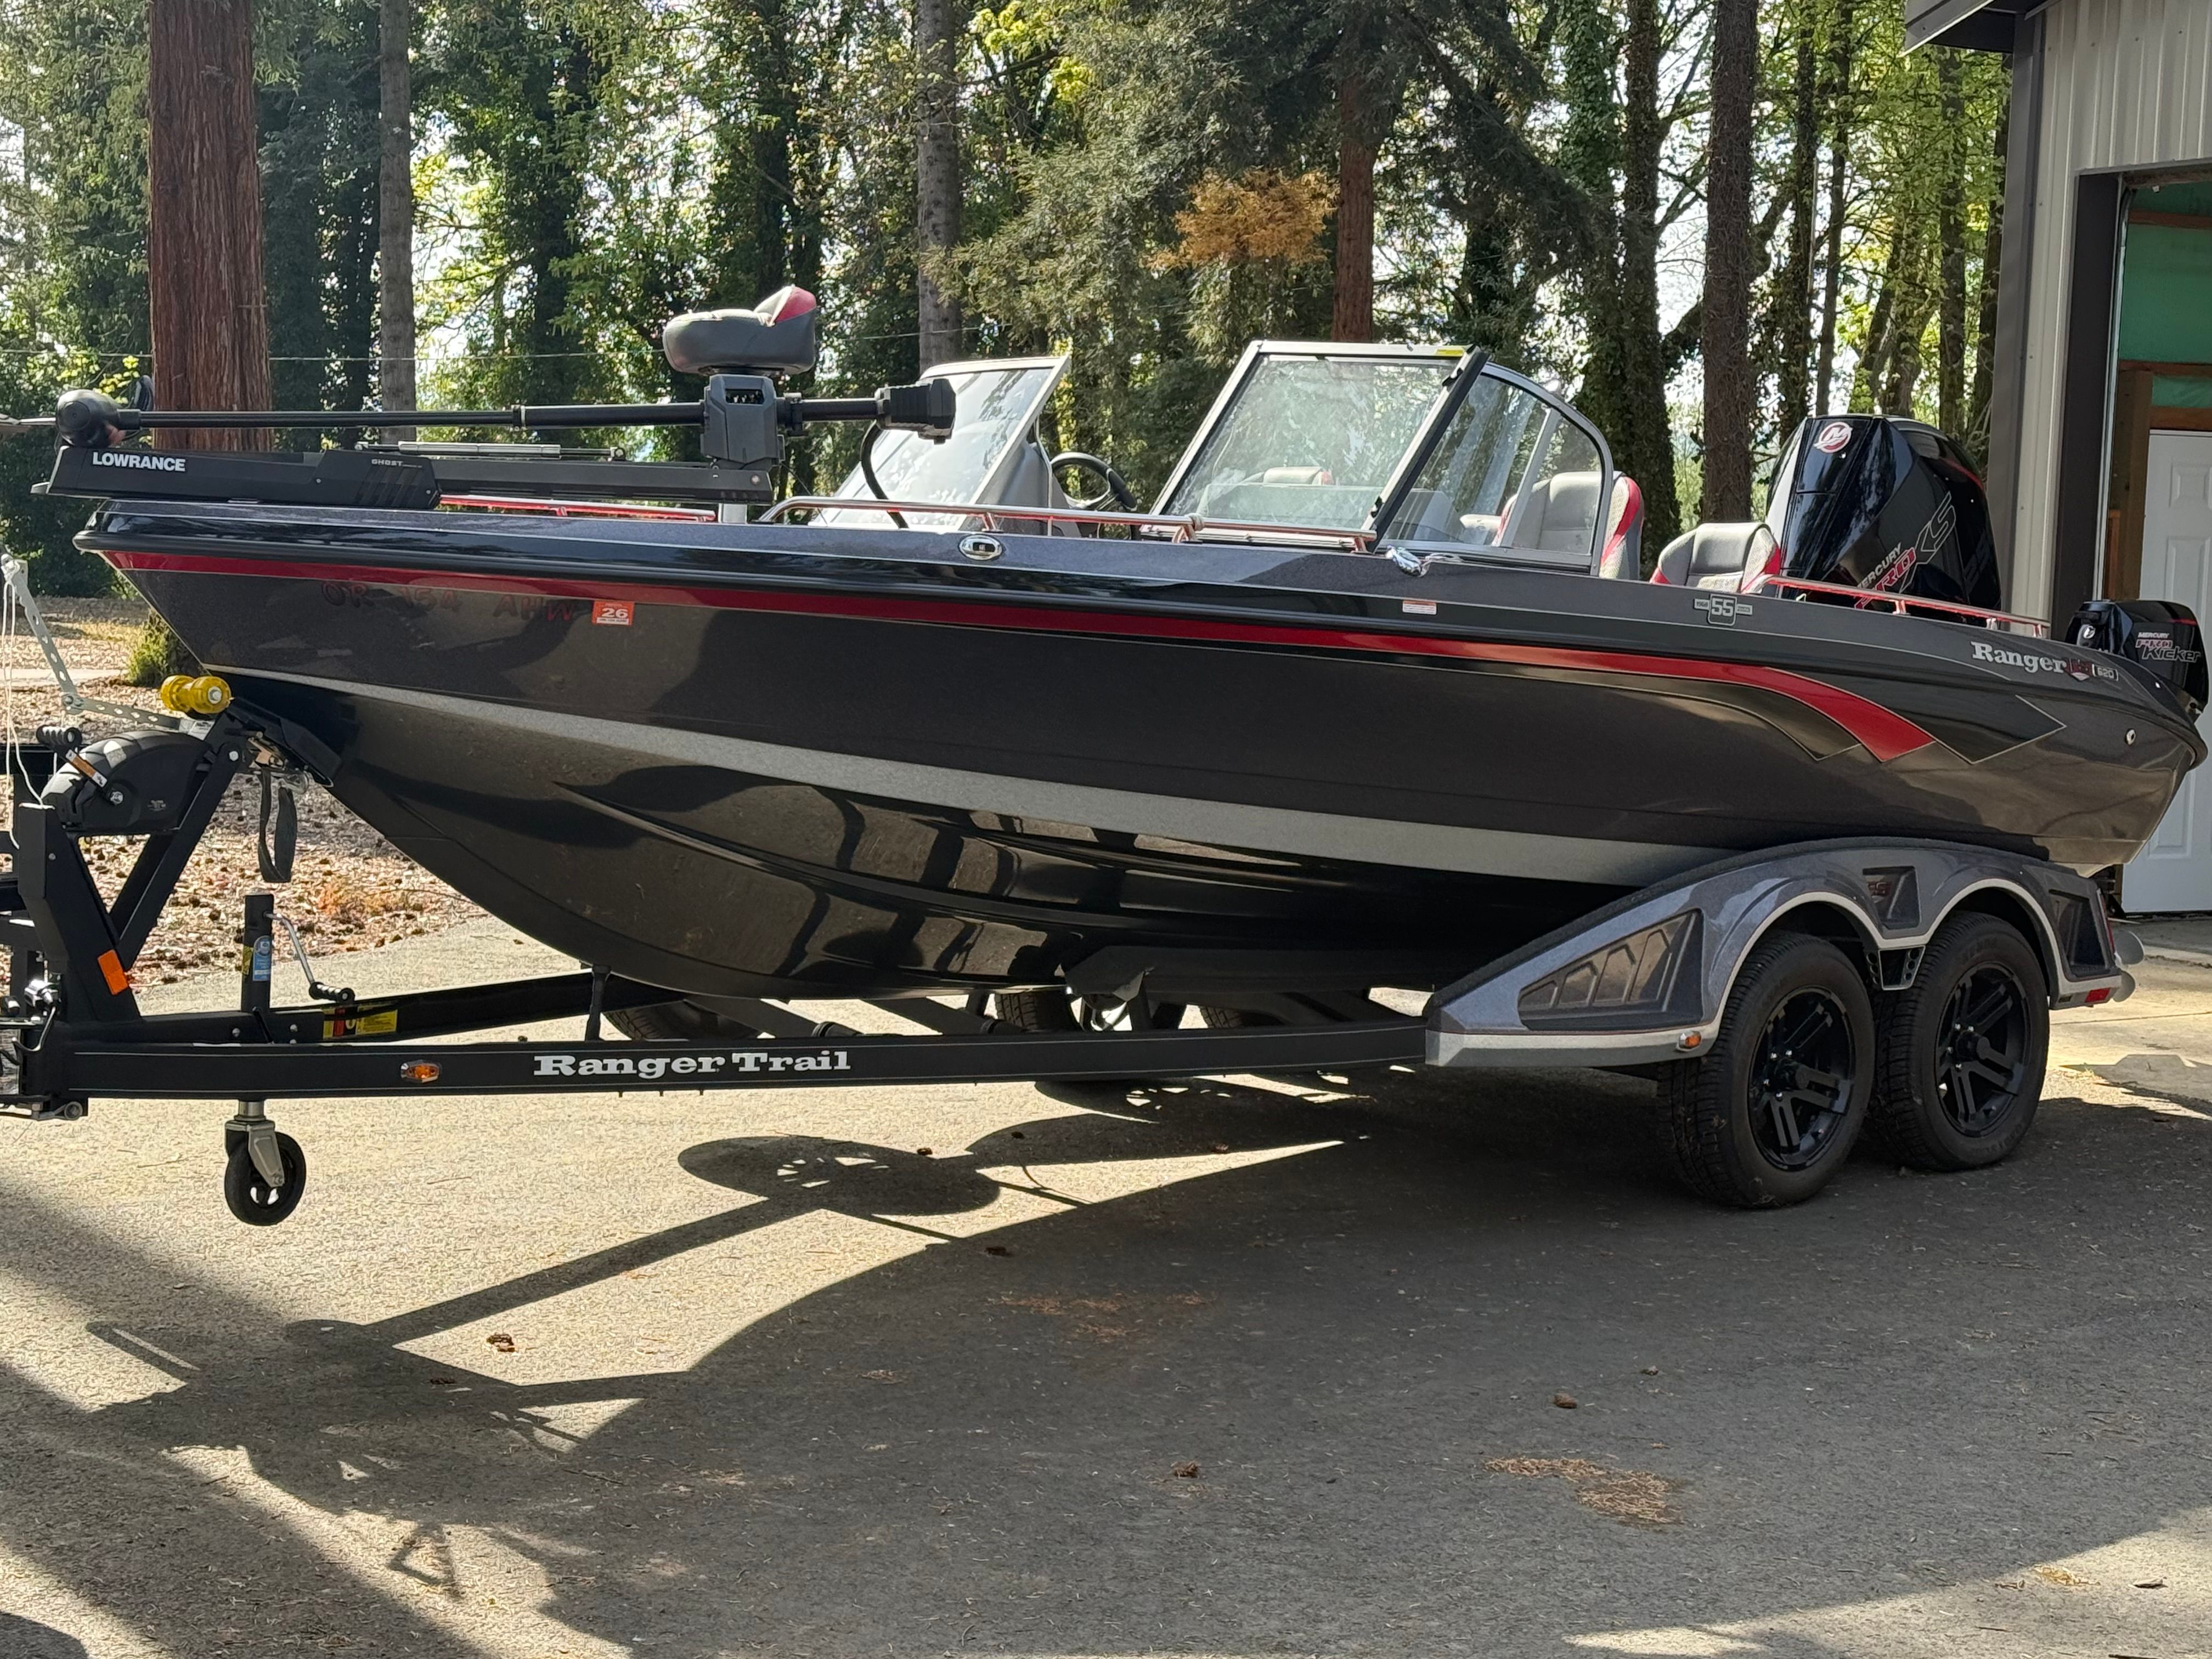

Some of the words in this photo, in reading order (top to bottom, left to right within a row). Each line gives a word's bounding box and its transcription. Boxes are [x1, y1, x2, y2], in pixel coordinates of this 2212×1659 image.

[92, 452, 186, 472] LOWRANCE
[601, 607, 629, 618] 26
[1711, 598, 1734, 617] 55
[1970, 641, 2067, 673] Ranger
[2097, 667, 2114, 679] 620
[533, 1054, 725, 1079] Ranger
[732, 1051, 851, 1072] Trail
